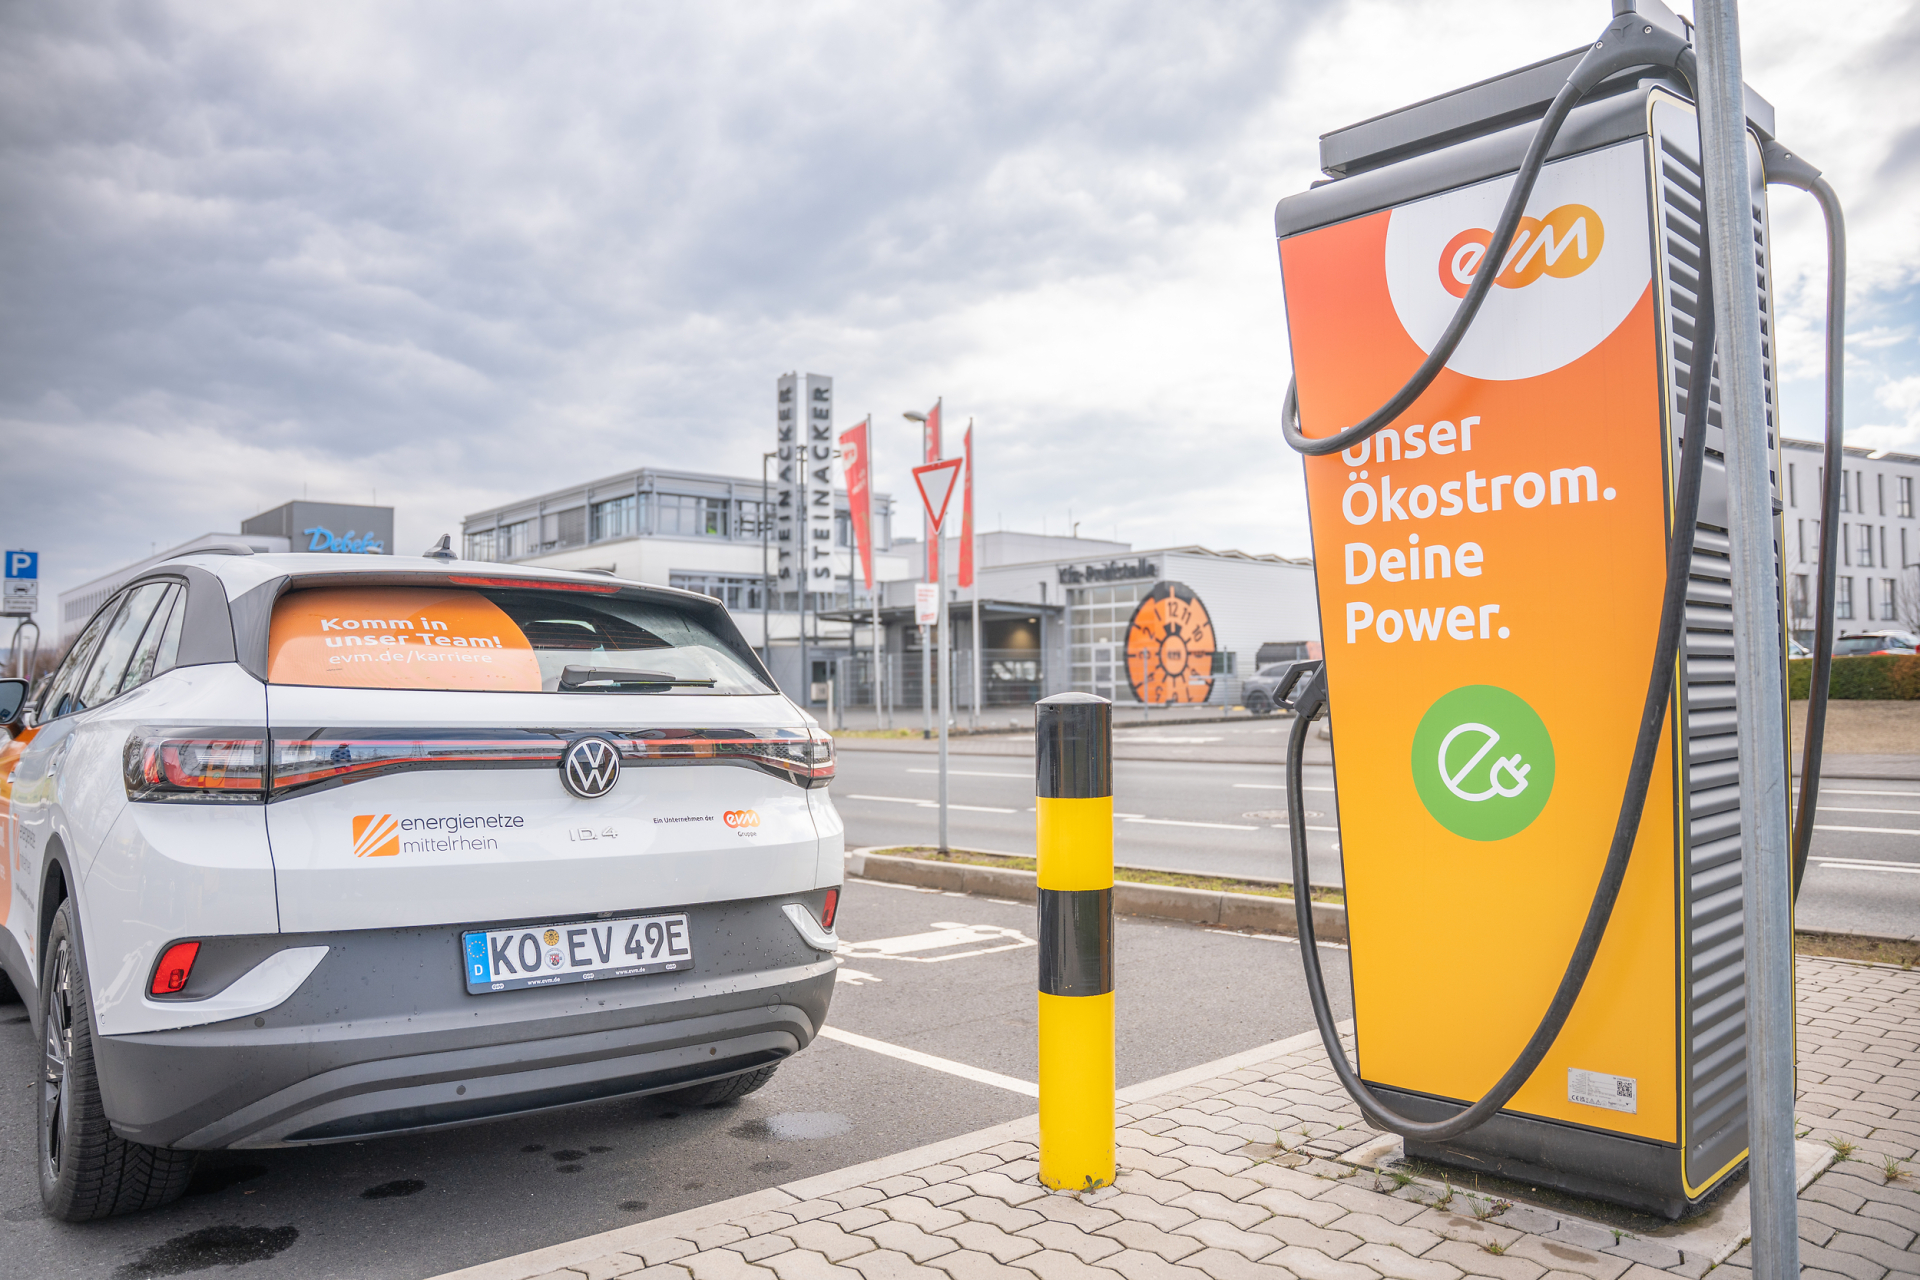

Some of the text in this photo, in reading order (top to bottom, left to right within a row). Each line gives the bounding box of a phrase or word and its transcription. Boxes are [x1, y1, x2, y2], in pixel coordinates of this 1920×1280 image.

[1341, 416, 1481, 467] Unser
[778, 386, 793, 580] STEINACKER
[812, 386, 831, 580] STEINACKER
[1341, 465, 1617, 526] Ökostrom.
[12, 553, 32, 577] P
[1344, 532, 1484, 585] Deine
[1167, 601, 1178, 617] 12
[320, 616, 448, 632] Komm in
[1346, 601, 1510, 644] Power.
[324, 632, 503, 649] unser Team!
[329, 650, 493, 665] evm.de/karriere
[401, 813, 524, 833] energienetze
[664, 815, 704, 824] Unternehmen
[725, 812, 759, 826] evm
[737, 830, 757, 838] Gruppe
[403, 835, 498, 853] mittelrhein
[490, 919, 689, 976] KO EV 49E
[474, 964, 483, 976] D
[615, 966, 646, 976] www.evm.de
[527, 976, 561, 986] www.evm.de
